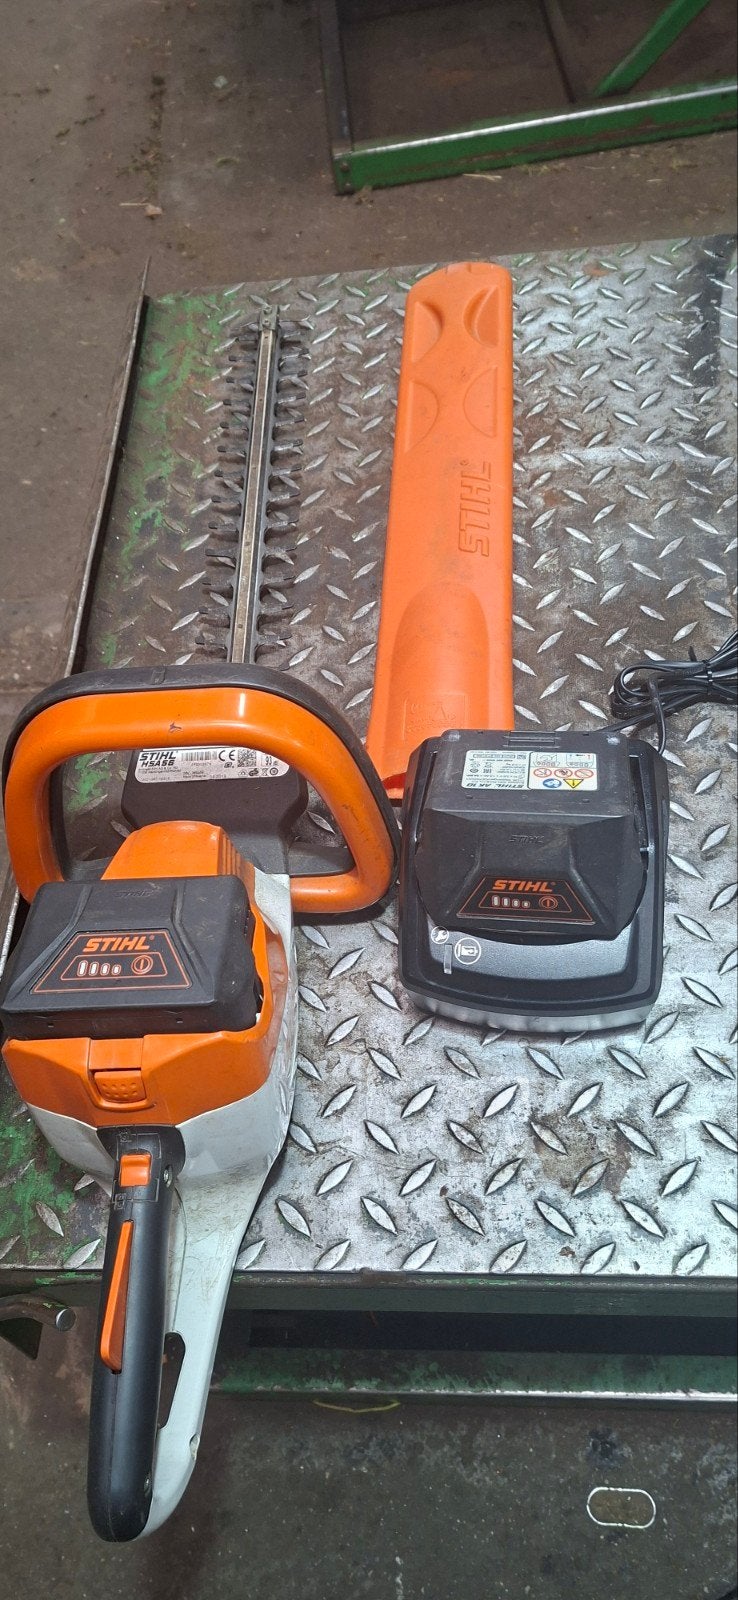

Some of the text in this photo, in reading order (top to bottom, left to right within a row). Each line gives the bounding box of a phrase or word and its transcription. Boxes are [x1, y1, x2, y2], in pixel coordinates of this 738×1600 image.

[458, 461, 491, 557] STIHL
[139, 751, 177, 762] STIHL
[218, 749, 236, 761] CE
[493, 879, 553, 893] STIHL
[83, 935, 150, 953] STIHL
